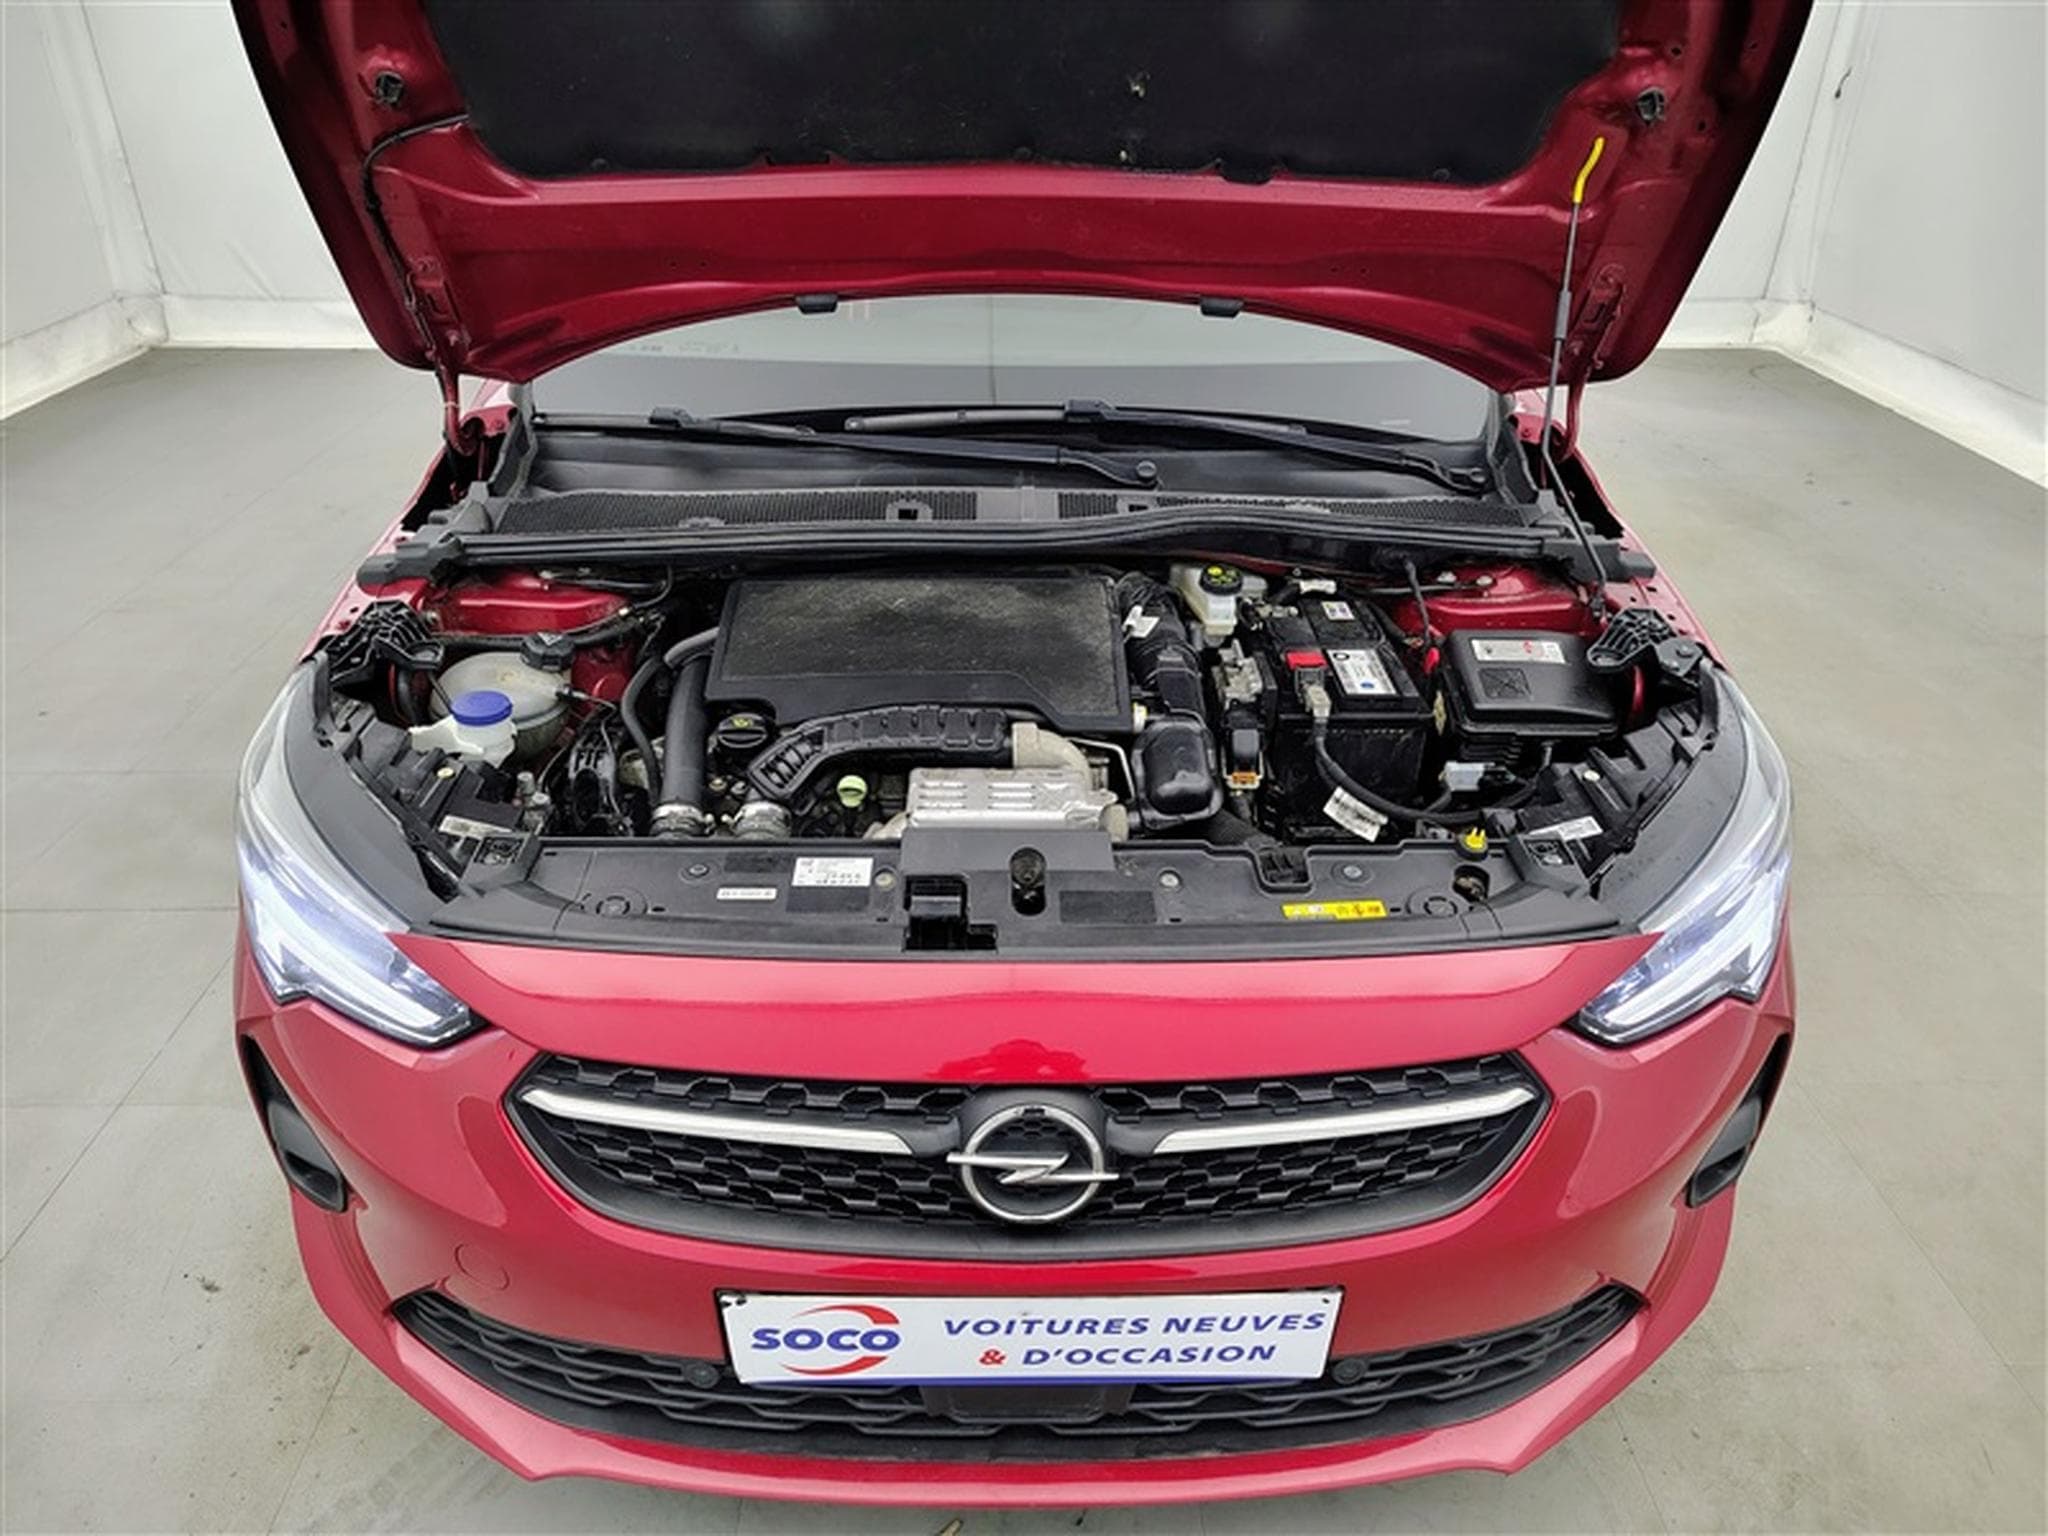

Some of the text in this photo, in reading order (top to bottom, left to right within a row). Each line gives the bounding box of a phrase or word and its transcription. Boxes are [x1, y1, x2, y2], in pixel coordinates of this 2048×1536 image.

[944, 1312, 1326, 1335] VOITURES NEUVES
[751, 1328, 900, 1351] SOCO
[979, 1345, 1276, 1365] & D'OCCASION
